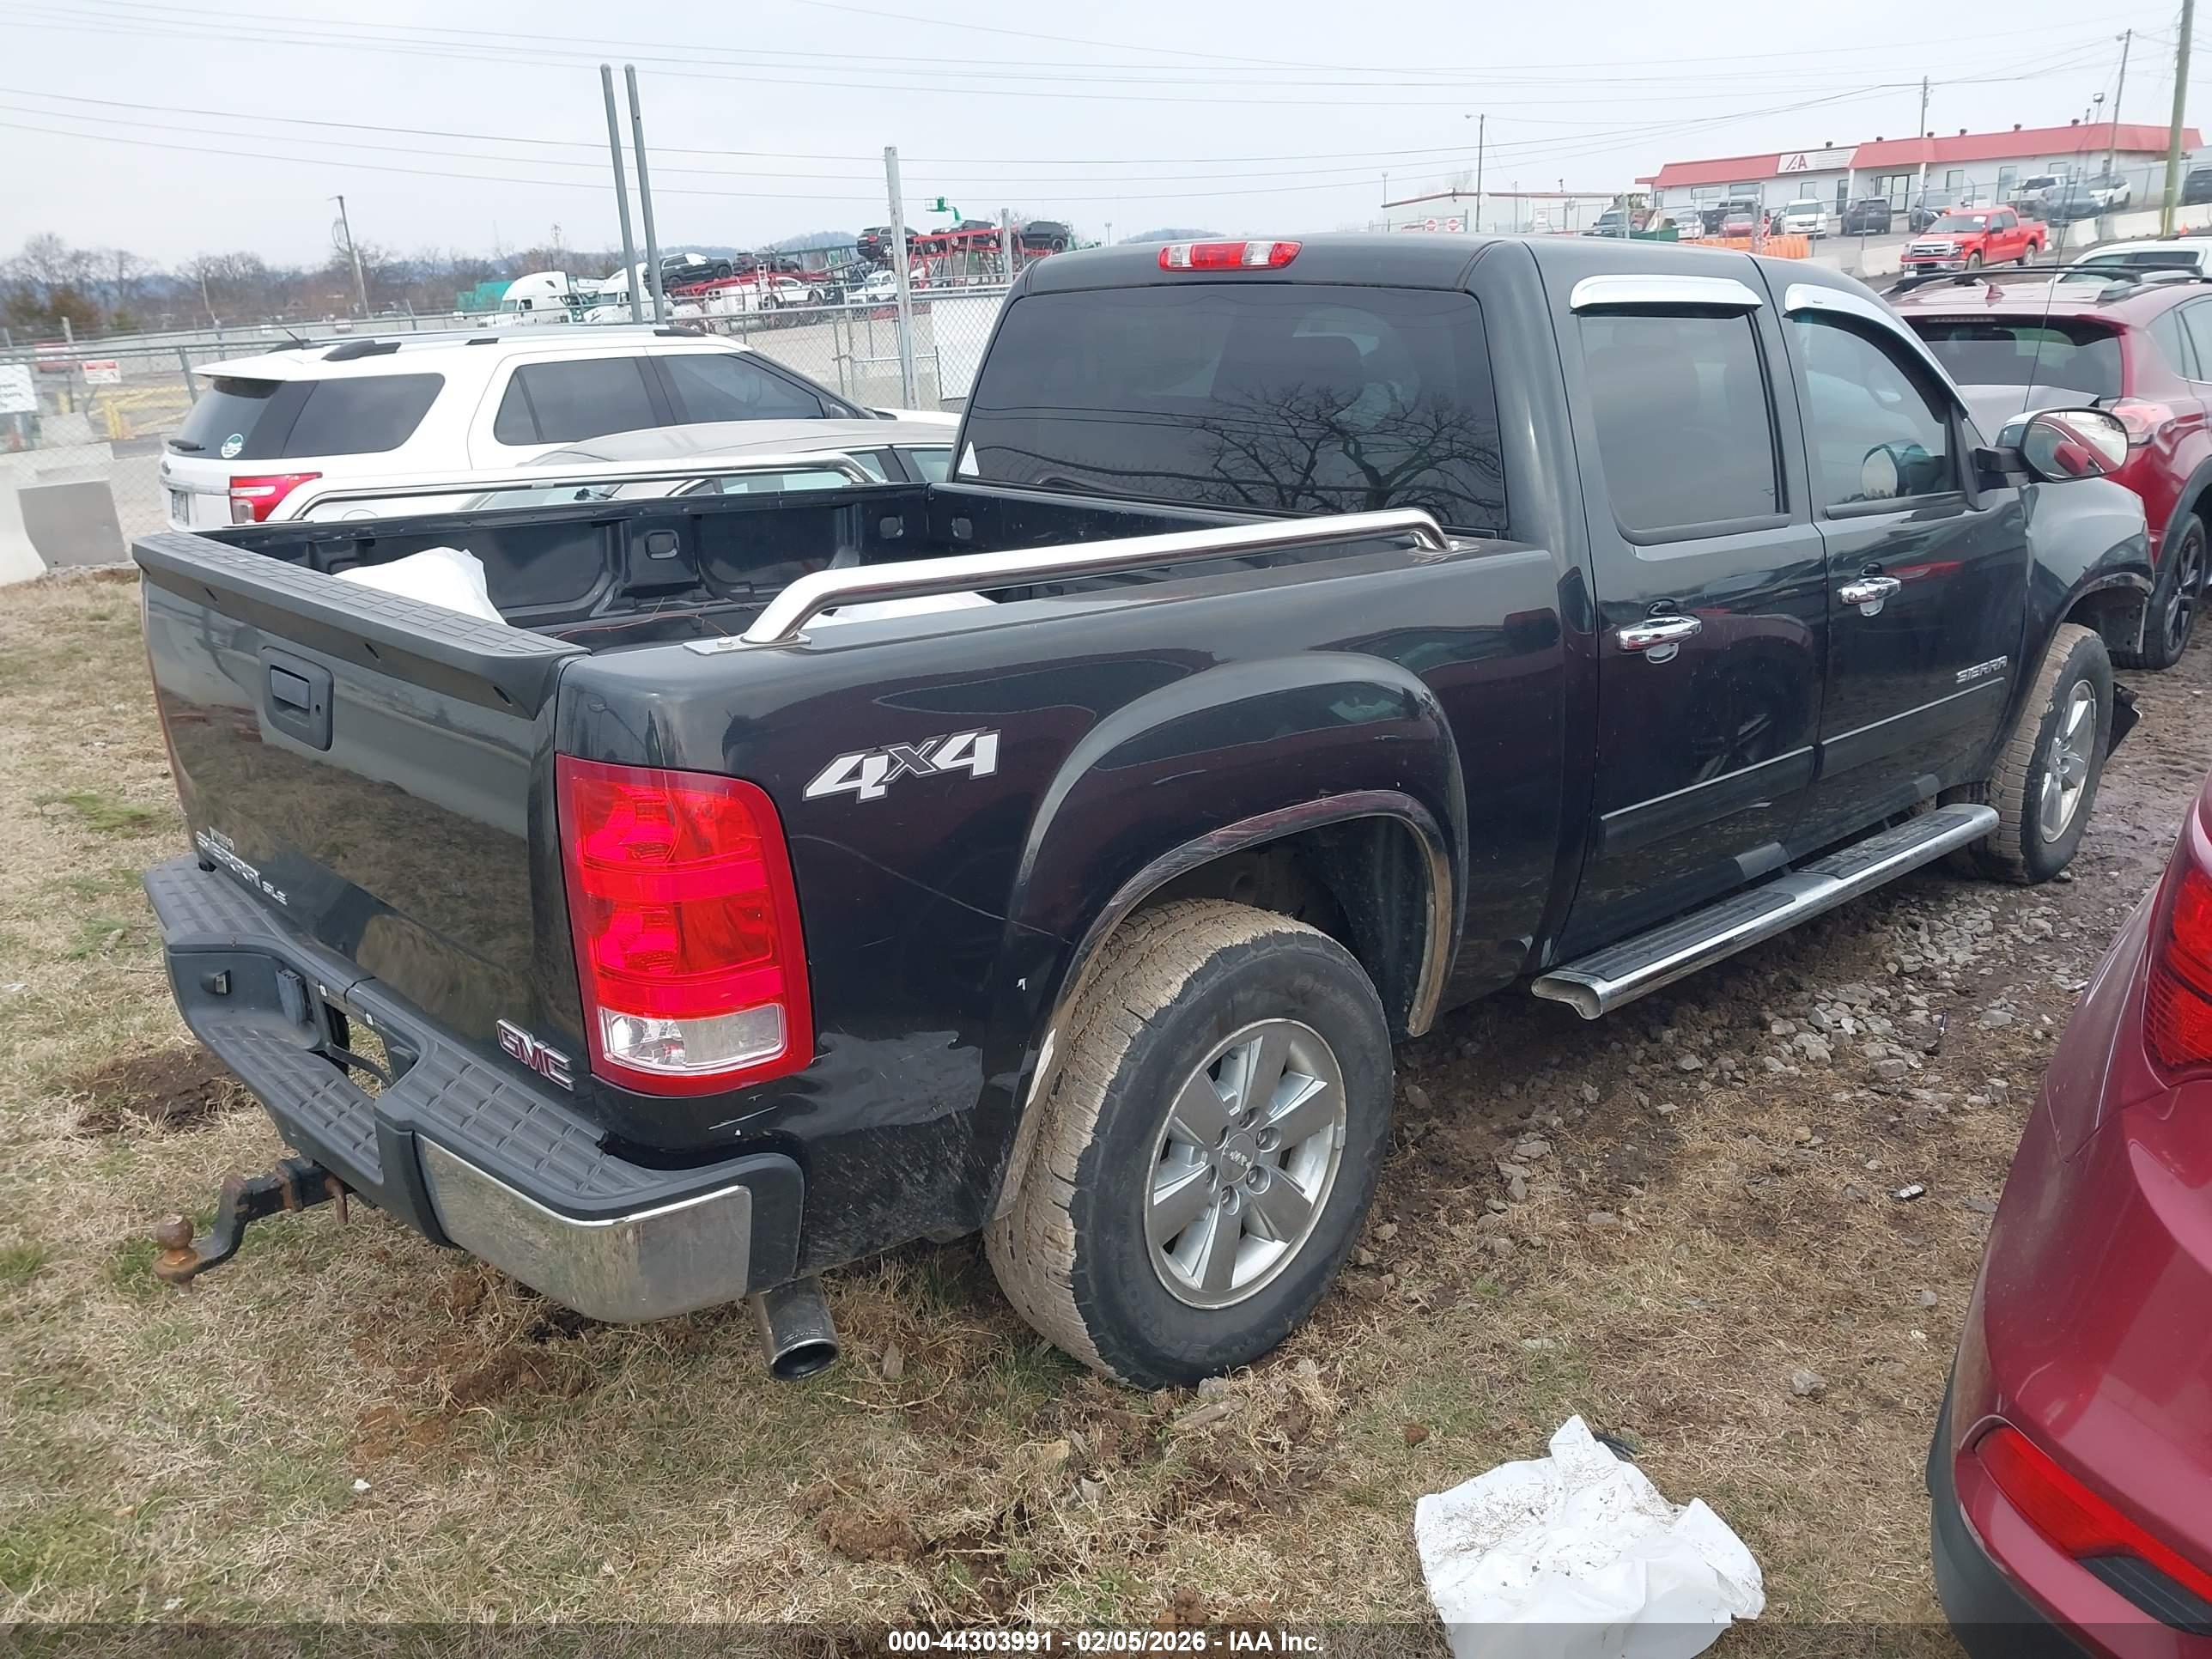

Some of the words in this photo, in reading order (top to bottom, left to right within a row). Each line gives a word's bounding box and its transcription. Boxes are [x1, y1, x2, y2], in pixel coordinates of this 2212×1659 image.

[1956, 655, 2008, 684] SIERRA
[196, 830, 261, 889] SIERRA
[262, 880, 288, 906] SLE
[496, 1018, 576, 1091] GMC
